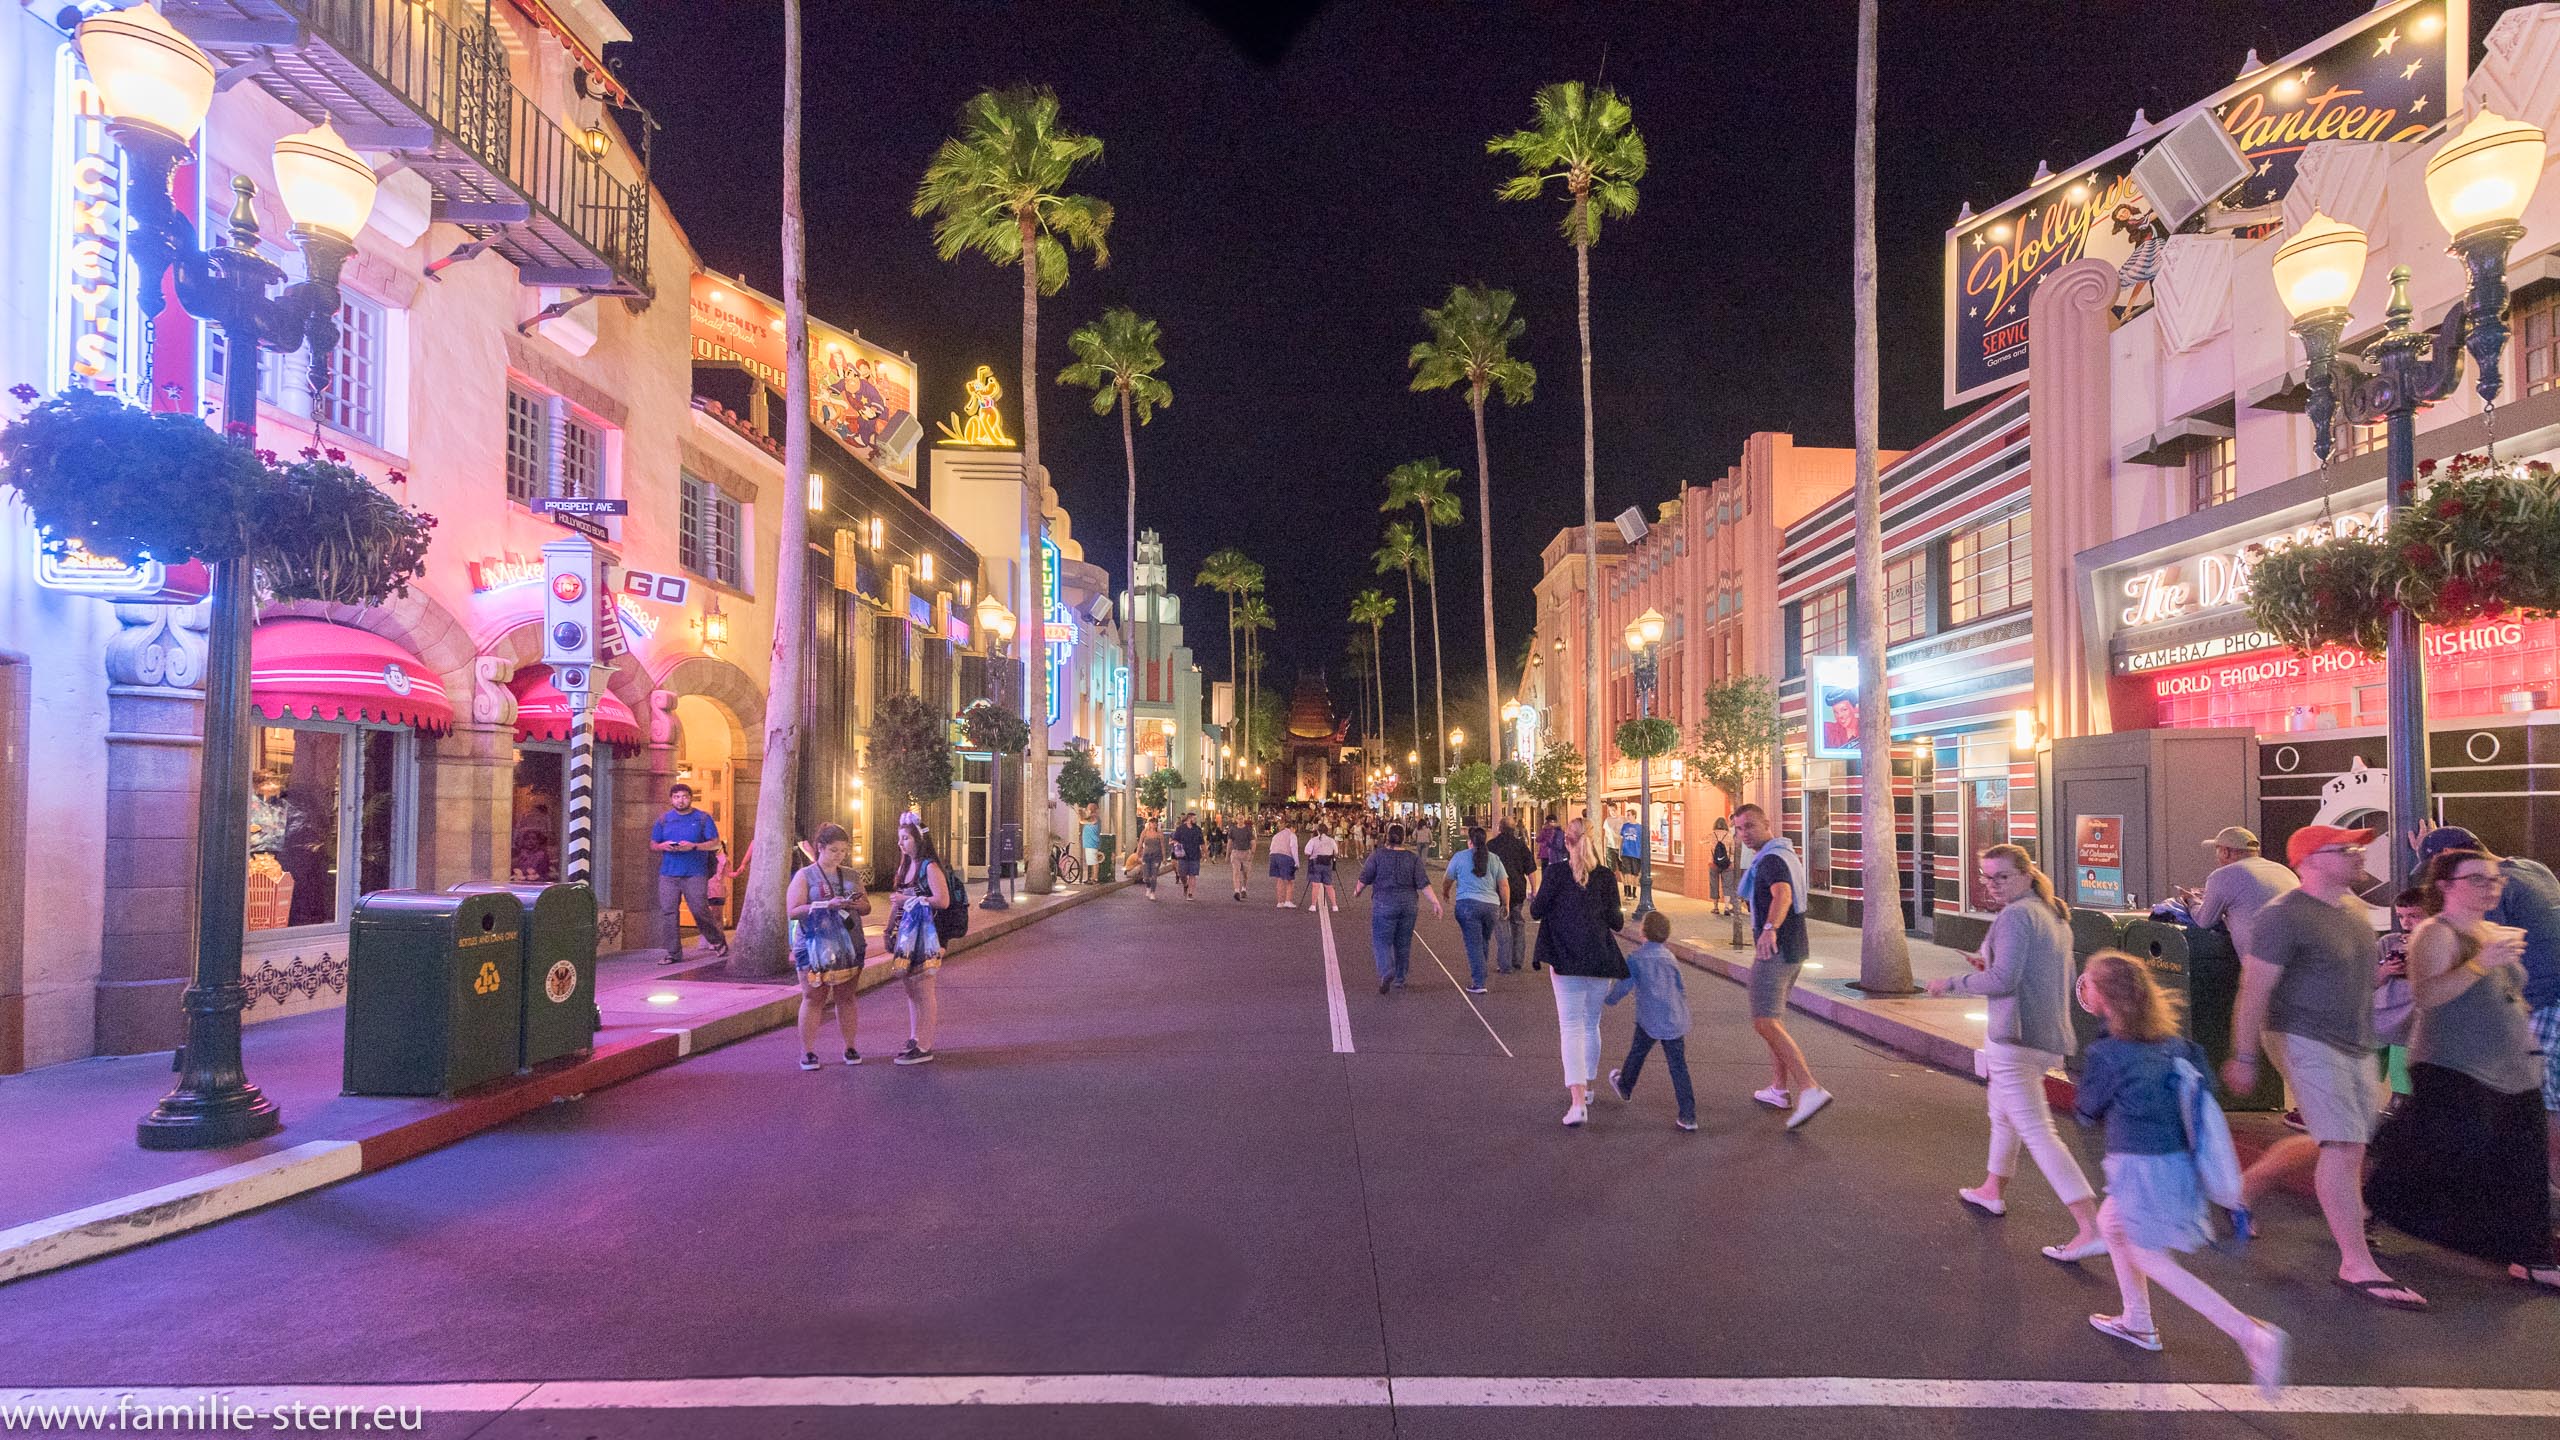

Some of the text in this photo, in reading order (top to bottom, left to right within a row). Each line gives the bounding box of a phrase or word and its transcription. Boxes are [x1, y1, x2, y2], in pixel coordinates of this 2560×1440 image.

[1967, 174, 2139, 321] Hollywo
[691, 298, 767, 338] ALT DISNEY'S
[716, 334, 726, 344] IN
[727, 321, 757, 348] Duck
[1983, 322, 2029, 356] SERVIC
[1987, 346, 2027, 367] Games and
[545, 501, 616, 512] PROSPECT AVE.
[558, 513, 592, 534] HOLLYWOOD
[482, 554, 544, 589] Micke
[624, 570, 685, 603] GO
[2122, 568, 2187, 626] The
[2133, 641, 2210, 670] CAMERAS
[2157, 676, 2211, 697] WORLD
[2220, 658, 2299, 687] FAMOUS
[2333, 781, 2345, 793] 25
[2355, 774, 2368, 784] 50
[2081, 879, 2119, 891] MICKEY'S
